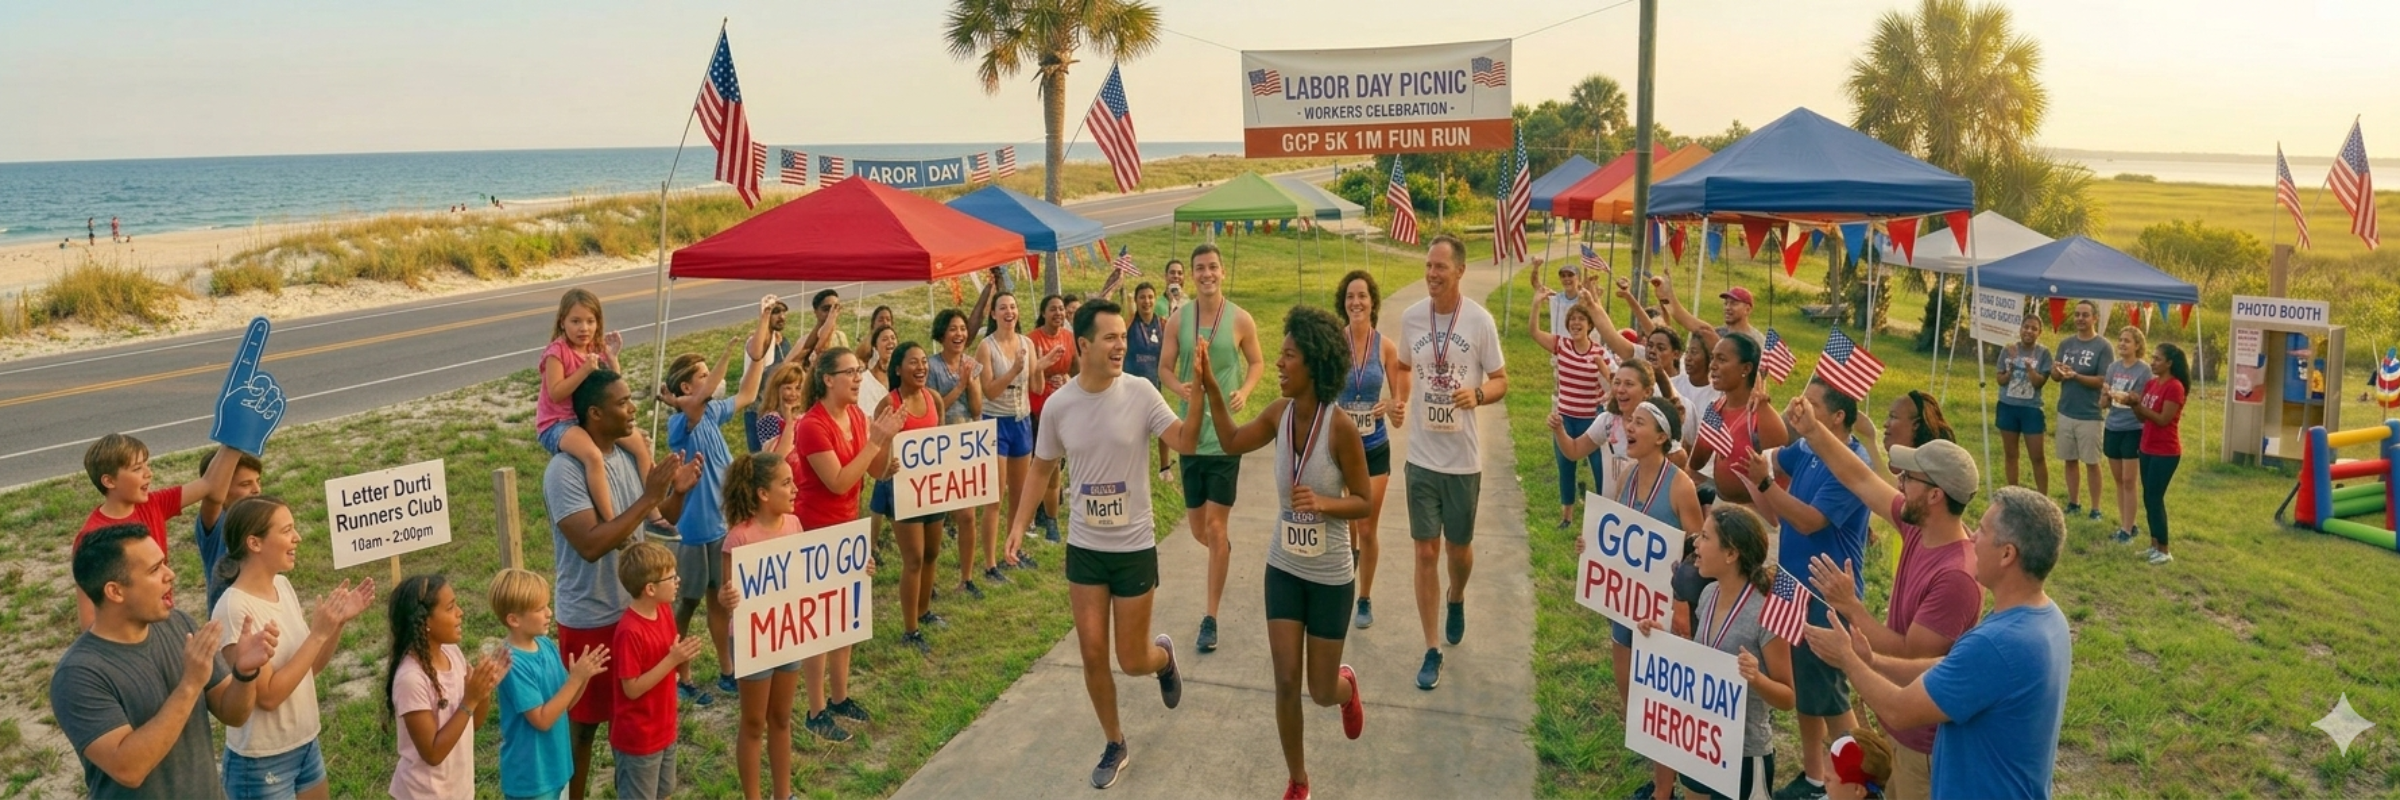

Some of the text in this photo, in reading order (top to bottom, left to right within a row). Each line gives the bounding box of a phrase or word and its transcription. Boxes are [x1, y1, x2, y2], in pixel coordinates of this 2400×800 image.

[1284, 69, 1467, 100] LABOR DAY PICNIC
[1304, 104, 1362, 120] WORKERS
[1366, 102, 1448, 117] CELEBRATION
[1281, 126, 1471, 152] GCP 5K 1M FUN RUN
[927, 163, 960, 182] DAY
[2237, 302, 2322, 321] PHOTO BOOTH
[1428, 406, 1455, 423] DOK
[901, 428, 991, 470] GCP 5K
[341, 473, 431, 508] Letter Durti
[909, 462, 987, 508] YEAH!
[336, 494, 443, 533] Runners Club
[1086, 497, 1123, 517] Marti
[351, 536, 383, 552] 10am
[392, 525, 434, 543] 2:00pm
[1288, 526, 1318, 547] DUG
[1598, 512, 1668, 573] GCP
[738, 534, 868, 600] WAY TO GO
[750, 581, 861, 659] MARTI!
[1634, 649, 1743, 721] LABOR DAY
[1643, 697, 1727, 769] HEROES.
